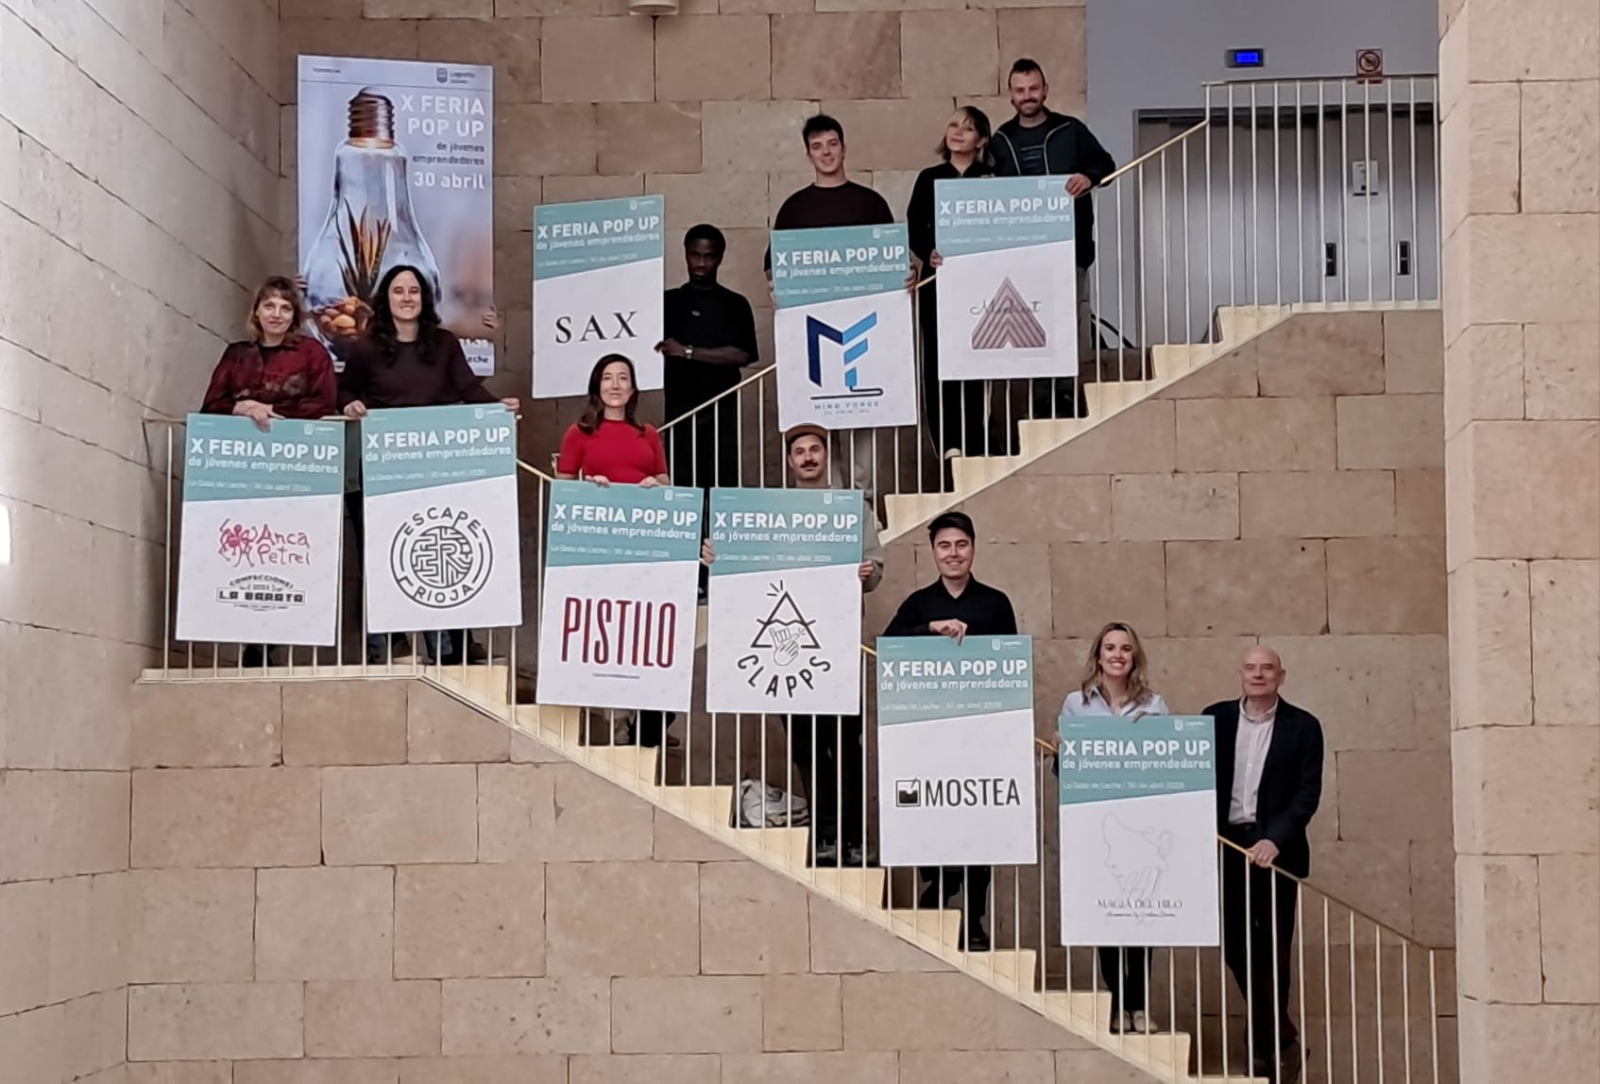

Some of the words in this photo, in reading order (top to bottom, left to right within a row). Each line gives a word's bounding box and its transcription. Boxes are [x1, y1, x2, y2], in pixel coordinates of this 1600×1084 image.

[401, 94, 414, 112] X
[421, 95, 485, 116] FERIA
[407, 117, 450, 136] POP
[456, 120, 485, 138] UP
[436, 142, 447, 150] de
[449, 142, 485, 153] jóvenes
[413, 171, 435, 187] 30
[440, 172, 485, 189] abril
[940, 200, 951, 215] X
[955, 199, 1006, 214] FERIA
[1009, 198, 1043, 213] POP
[1047, 196, 1070, 211] UP
[537, 225, 548, 239] X
[552, 221, 600, 238] FERIA
[602, 218, 635, 234] POP
[638, 215, 660, 231] UP
[938, 217, 949, 227] de
[536, 240, 548, 250] de
[775, 251, 788, 267] X
[791, 249, 842, 266] FERIA
[845, 247, 879, 263] POP
[882, 245, 905, 260] UP
[775, 268, 788, 278] de
[555, 311, 638, 344] SAX
[366, 433, 380, 449] X
[384, 430, 440, 448] FERIA
[444, 428, 481, 445] POP
[485, 426, 511, 443] UP
[190, 437, 204, 454] X
[208, 438, 266, 457] FERIA
[271, 442, 309, 459] POP
[313, 444, 340, 461] UP
[365, 451, 379, 462] de
[381, 449, 424, 463] jóvenes
[188, 456, 202, 467] de
[204, 457, 248, 469] jóvenes
[404, 506, 482, 539] ESCAPE
[553, 503, 566, 519] X
[571, 504, 626, 523] FERIA
[631, 507, 668, 525] POP
[673, 510, 698, 527] UP
[714, 512, 727, 528] X
[731, 512, 787, 528] FERIA
[791, 513, 829, 529] POP
[833, 514, 858, 529] UP
[256, 523, 311, 549] Anca
[551, 522, 565, 532] de
[567, 522, 609, 535] jóvenes
[712, 530, 726, 541] de
[728, 530, 770, 544] jóvenes
[413, 582, 474, 603] RIOJA
[561, 596, 676, 669] PISTILO
[737, 654, 831, 698] CLAPPS
[881, 660, 895, 677] X
[899, 660, 956, 677] FERIA
[960, 659, 998, 676] POP
[1002, 659, 1028, 675] UP
[880, 681, 893, 690] de
[896, 679, 939, 692] jóvenes
[1063, 740, 1077, 756] X
[1081, 739, 1138, 756] FERIA
[1142, 739, 1180, 756] POP
[1184, 739, 1211, 756] UP
[1062, 758, 1076, 769] de
[1078, 758, 1121, 771] jóvenes
[925, 777, 1021, 807] MOSTEA
